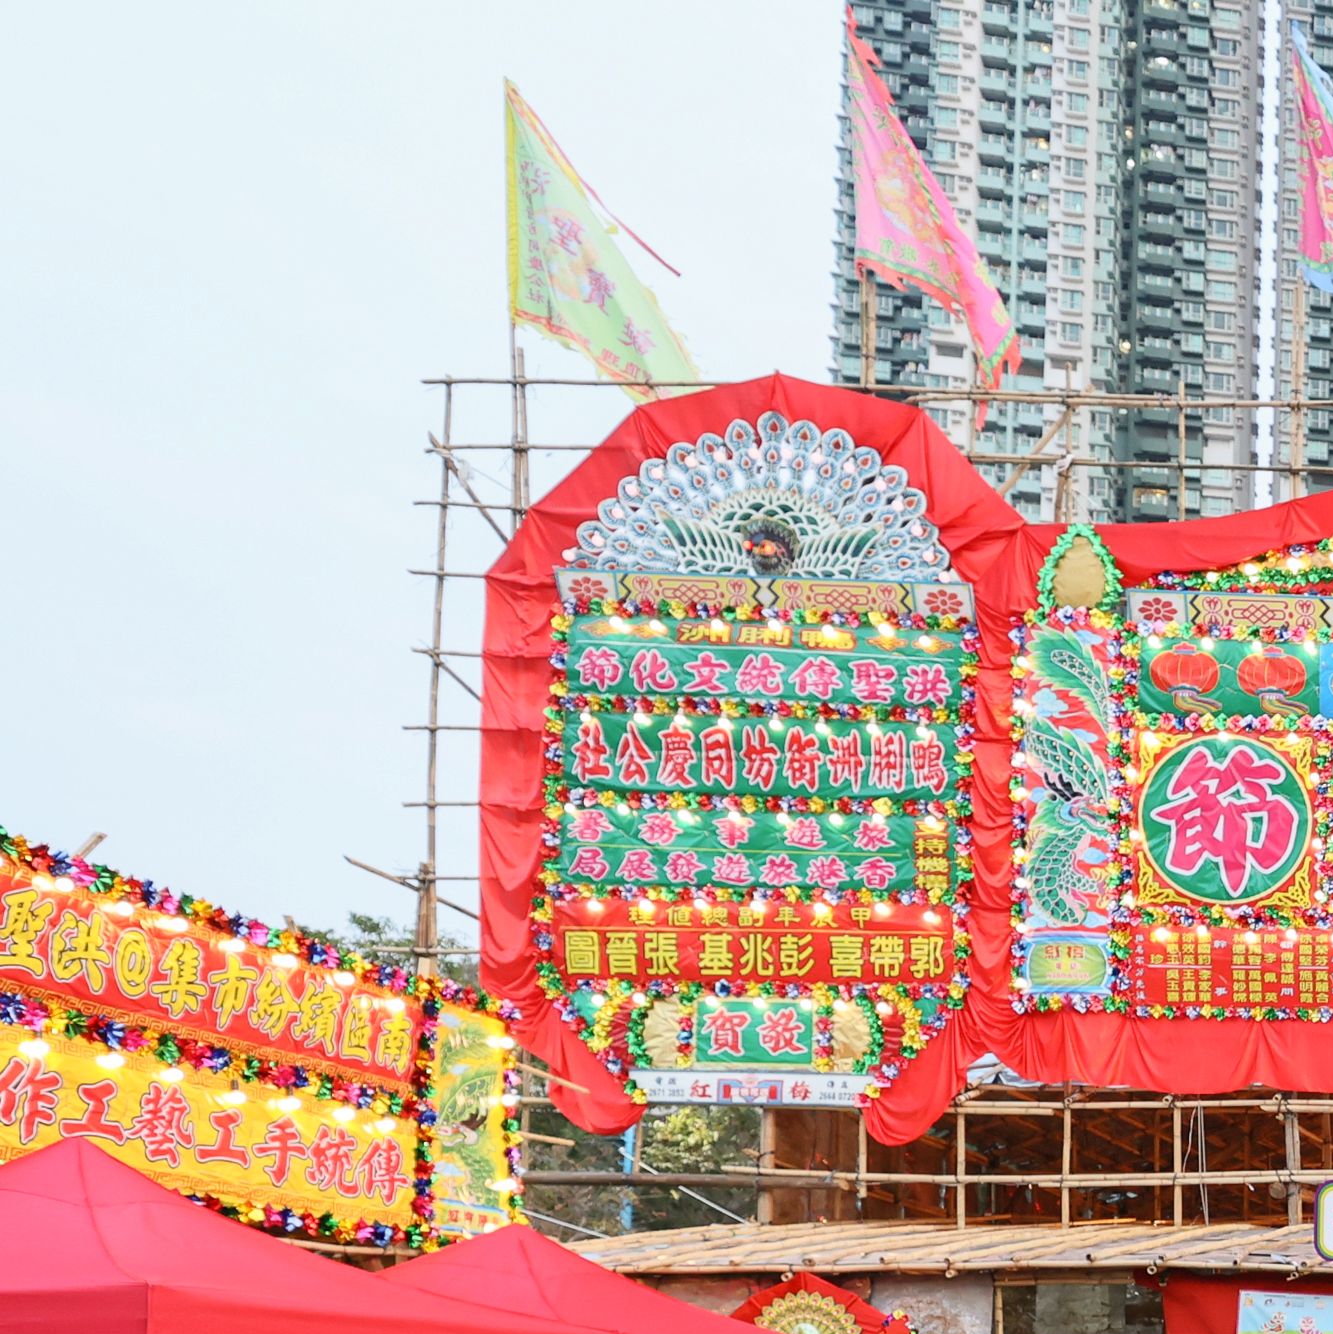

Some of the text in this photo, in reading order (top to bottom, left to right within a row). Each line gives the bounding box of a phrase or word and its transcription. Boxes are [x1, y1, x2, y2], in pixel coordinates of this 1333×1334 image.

[575, 647, 953, 705] 洪聖傳統文化節
[568, 846, 898, 890] 香港旅遊發展局
[699, 932, 815, 977] 彭兆基
[829, 934, 945, 979] 郭帶喜
[703, 1006, 807, 1056] 敬賀
